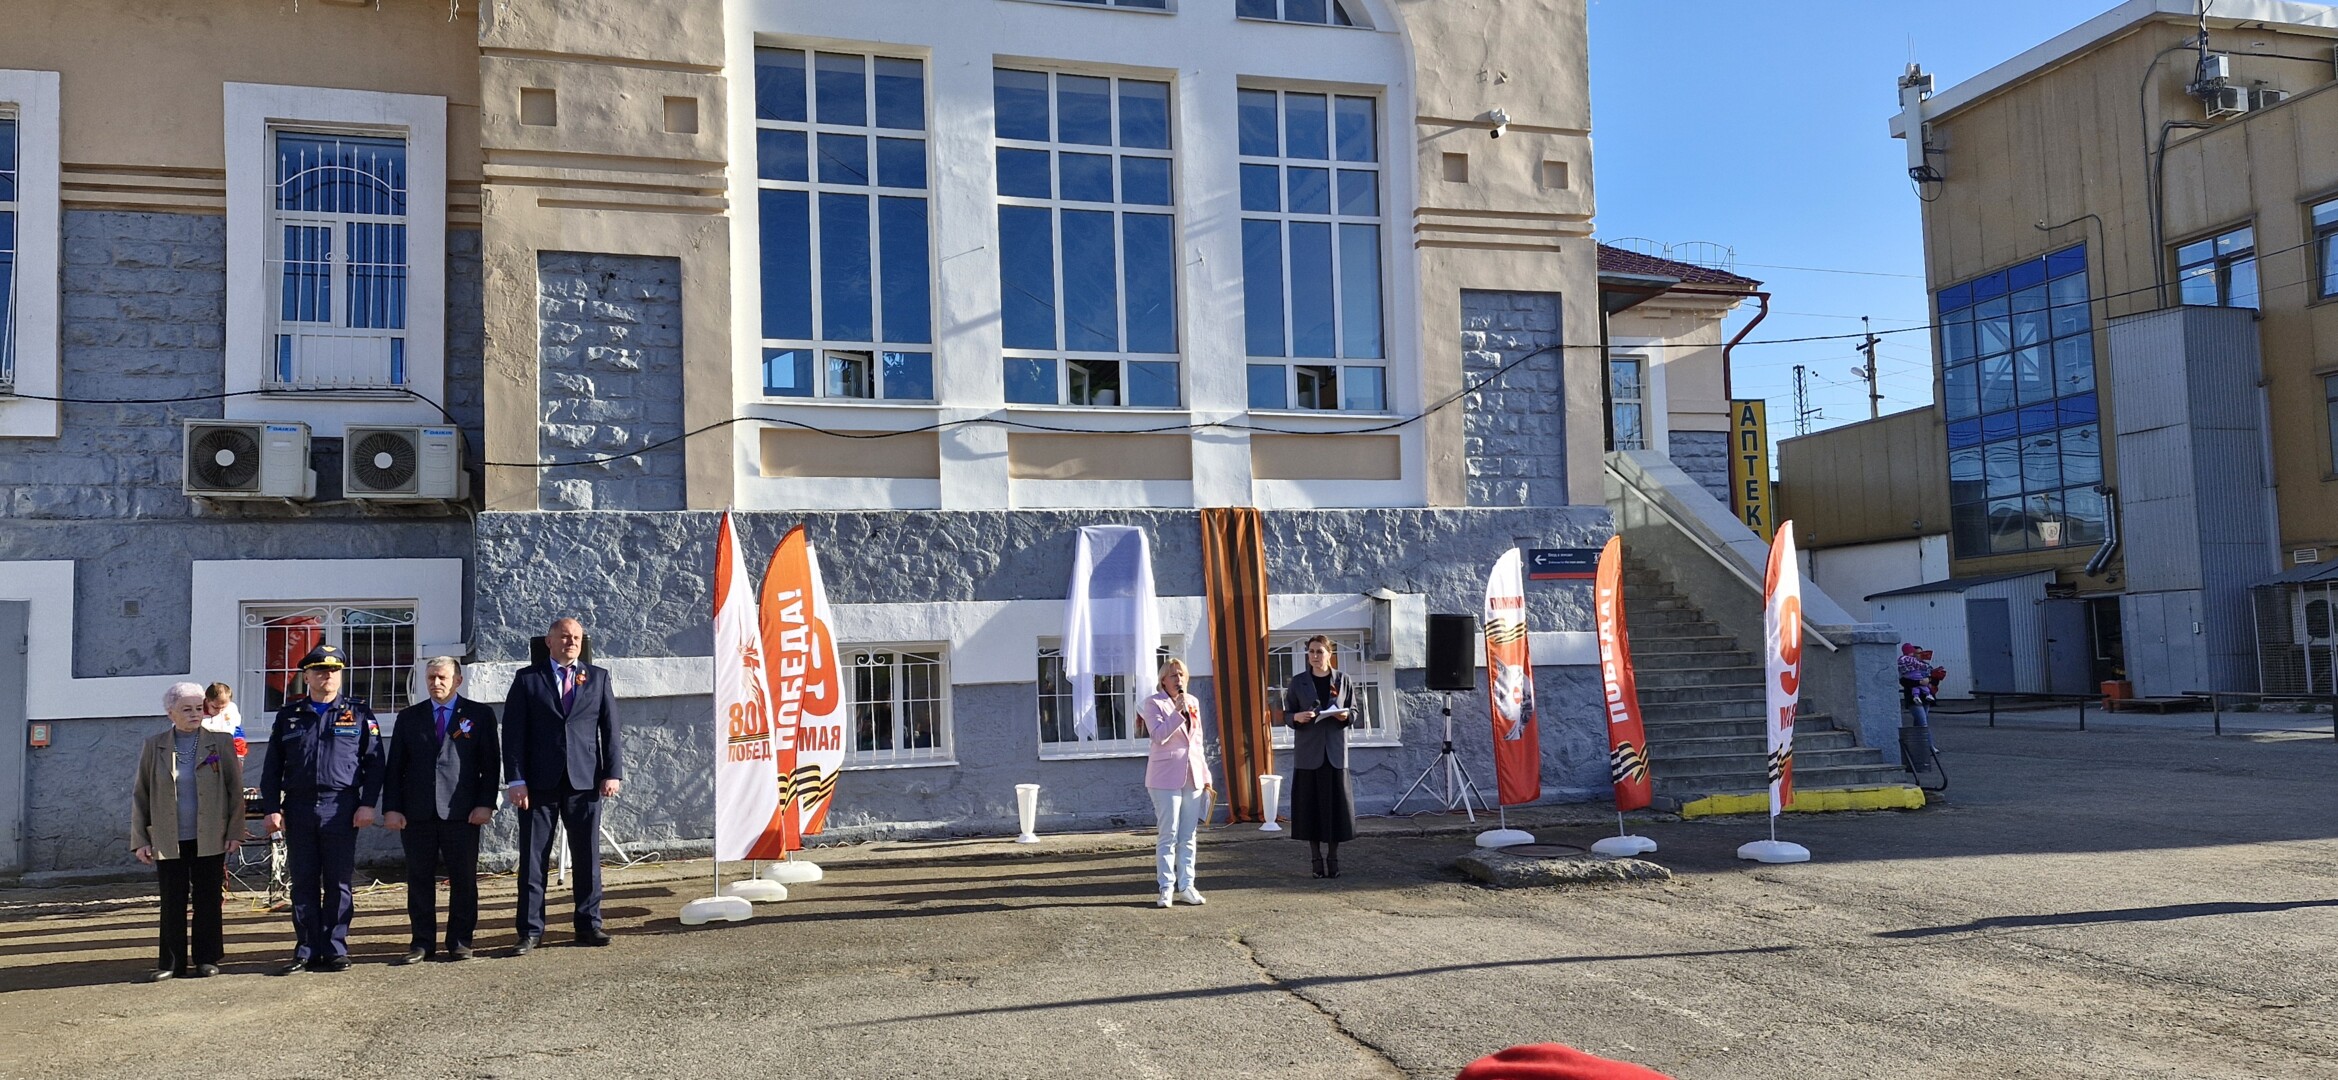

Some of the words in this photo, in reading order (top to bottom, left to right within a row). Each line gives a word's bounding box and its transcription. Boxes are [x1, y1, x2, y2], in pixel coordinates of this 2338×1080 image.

[1740, 405, 1762, 537] АПТЕК
[775, 588, 809, 750] ПОБЕДА!
[802, 616, 838, 716] 9
[1600, 588, 1629, 723] ПОБЕДА!
[1779, 595, 1801, 696] 9
[728, 741, 772, 762] ПОБЕД
[799, 726, 840, 751] МАЯ
